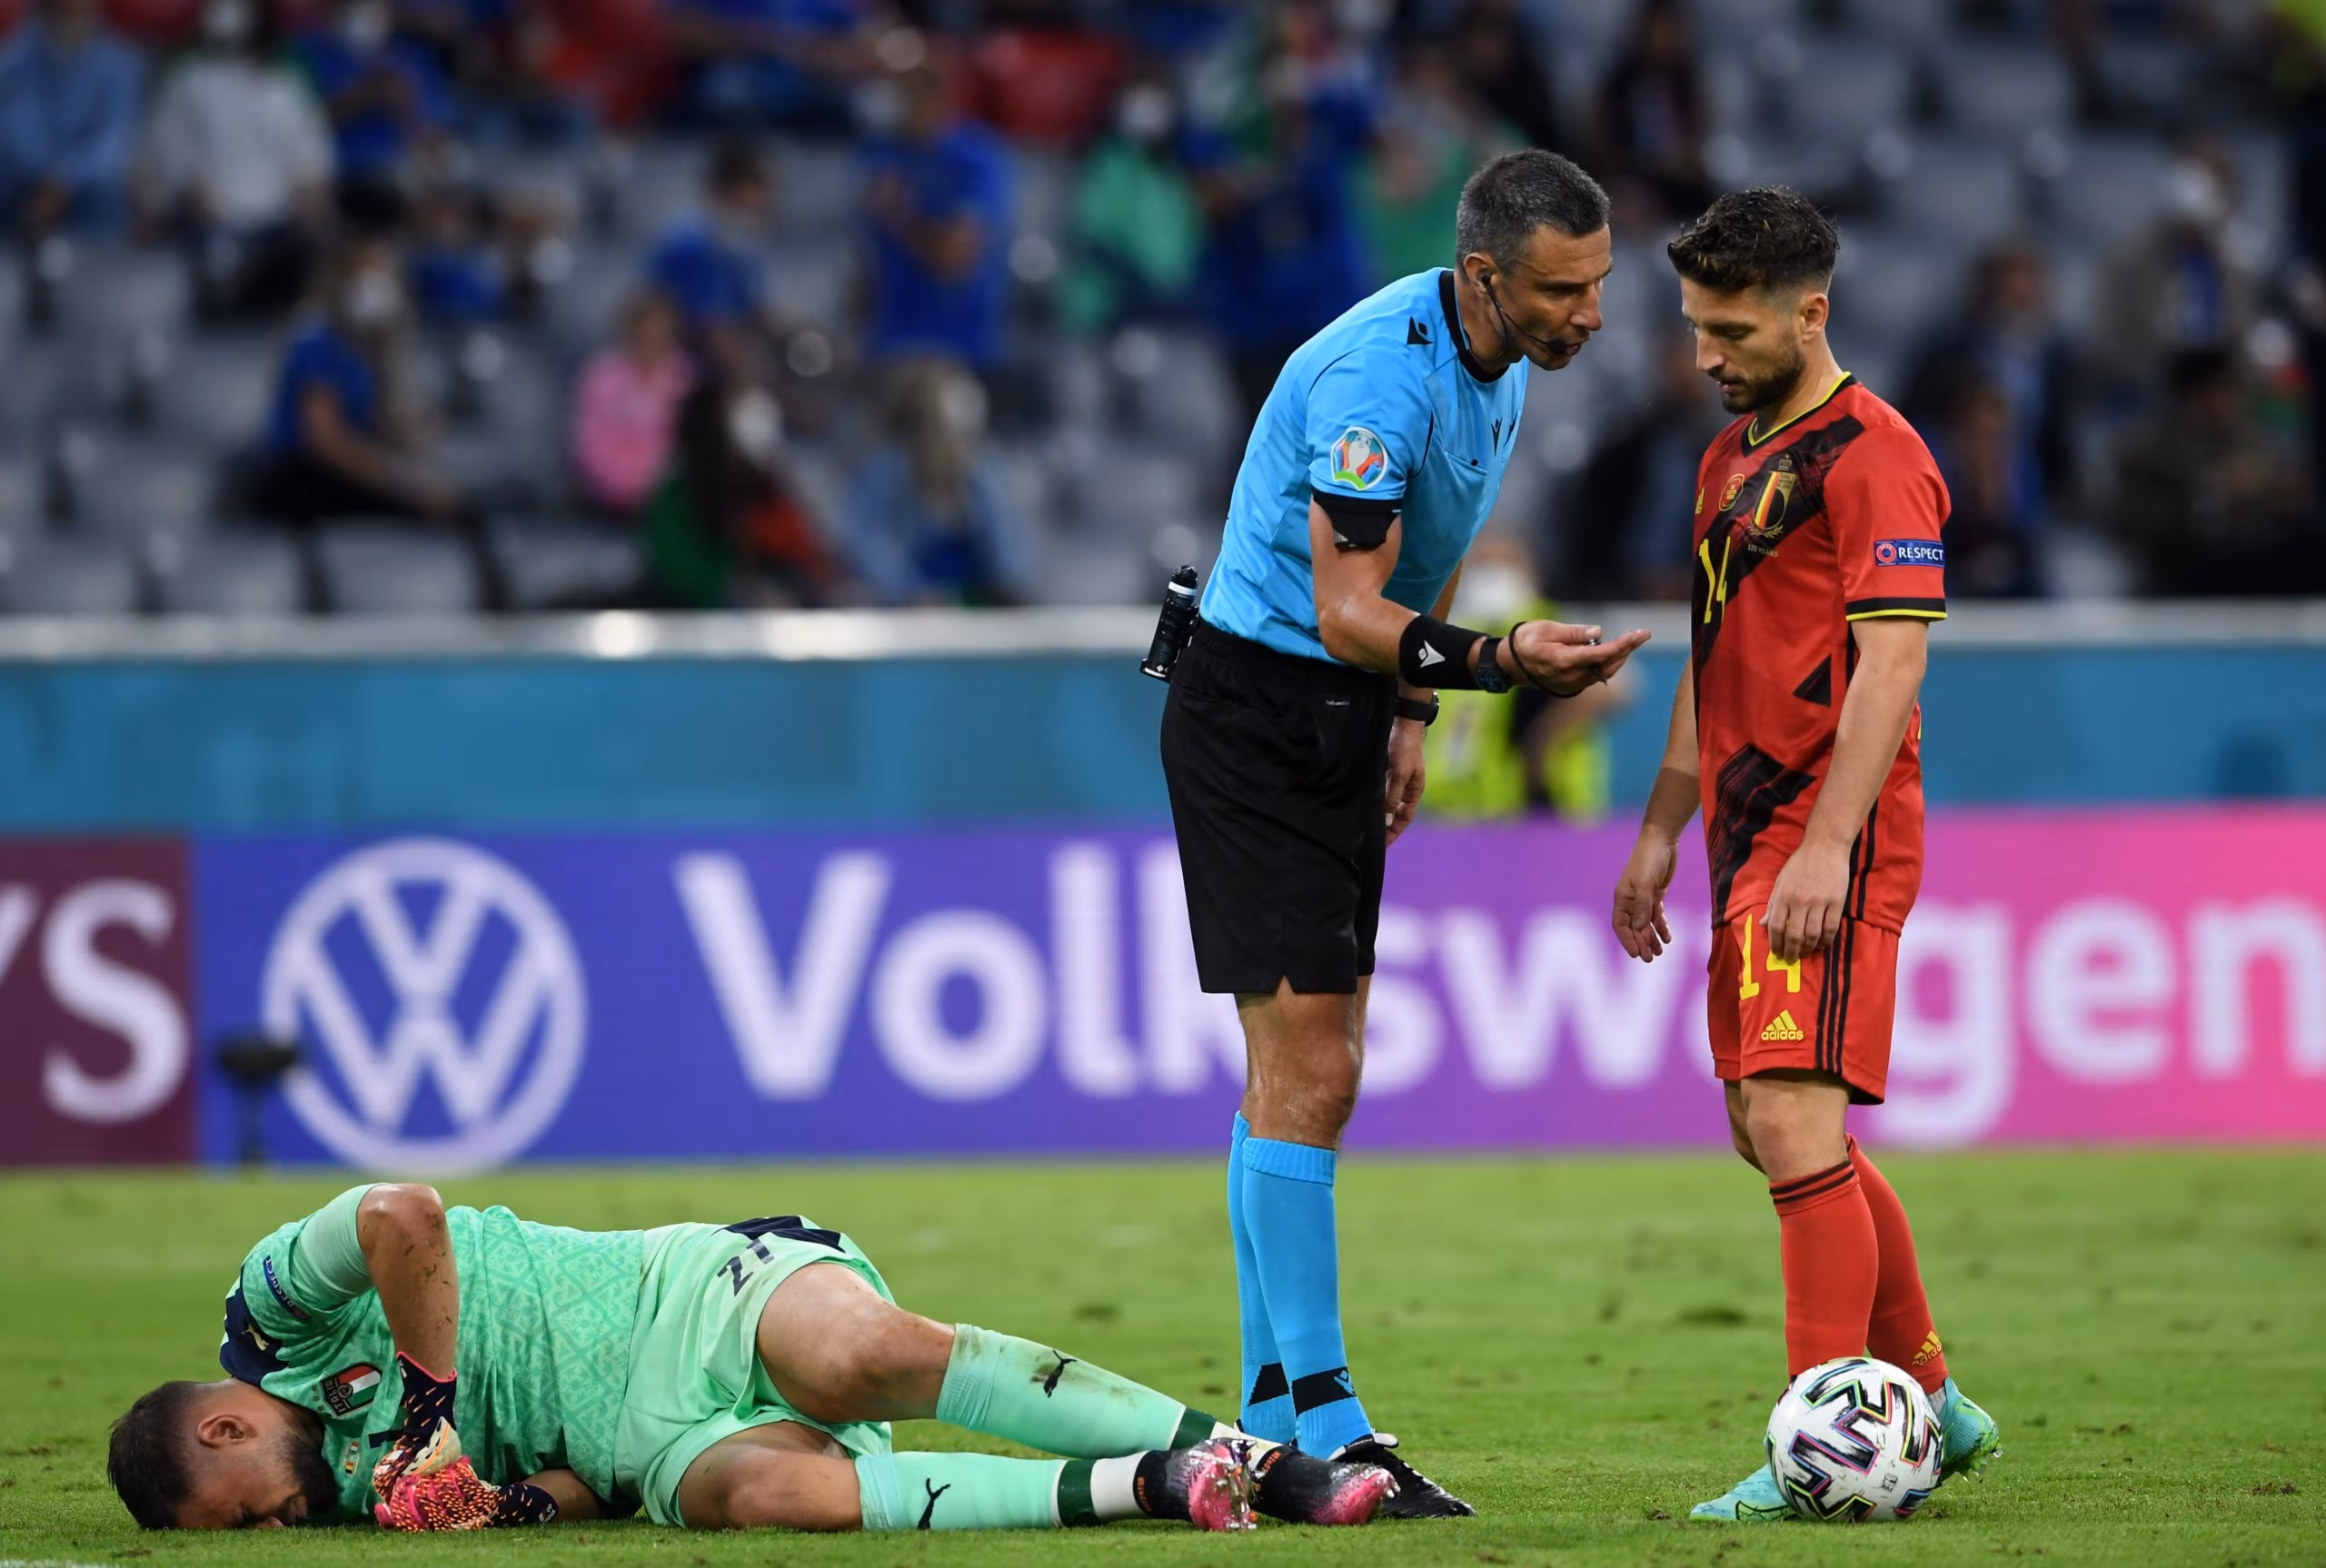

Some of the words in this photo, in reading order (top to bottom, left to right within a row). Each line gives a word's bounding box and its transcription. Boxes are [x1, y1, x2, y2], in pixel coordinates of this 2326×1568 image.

[1898, 547, 1943, 561] RESPECT
[1699, 536, 1731, 624] 14
[672, 841, 2326, 1150] Volkswgen
[1761, 1029, 1804, 1041] adidas
[265, 1258, 296, 1307] RESPECT
[1911, 1344, 1943, 1366] adida
[324, 1380, 346, 1414] ITALIA
